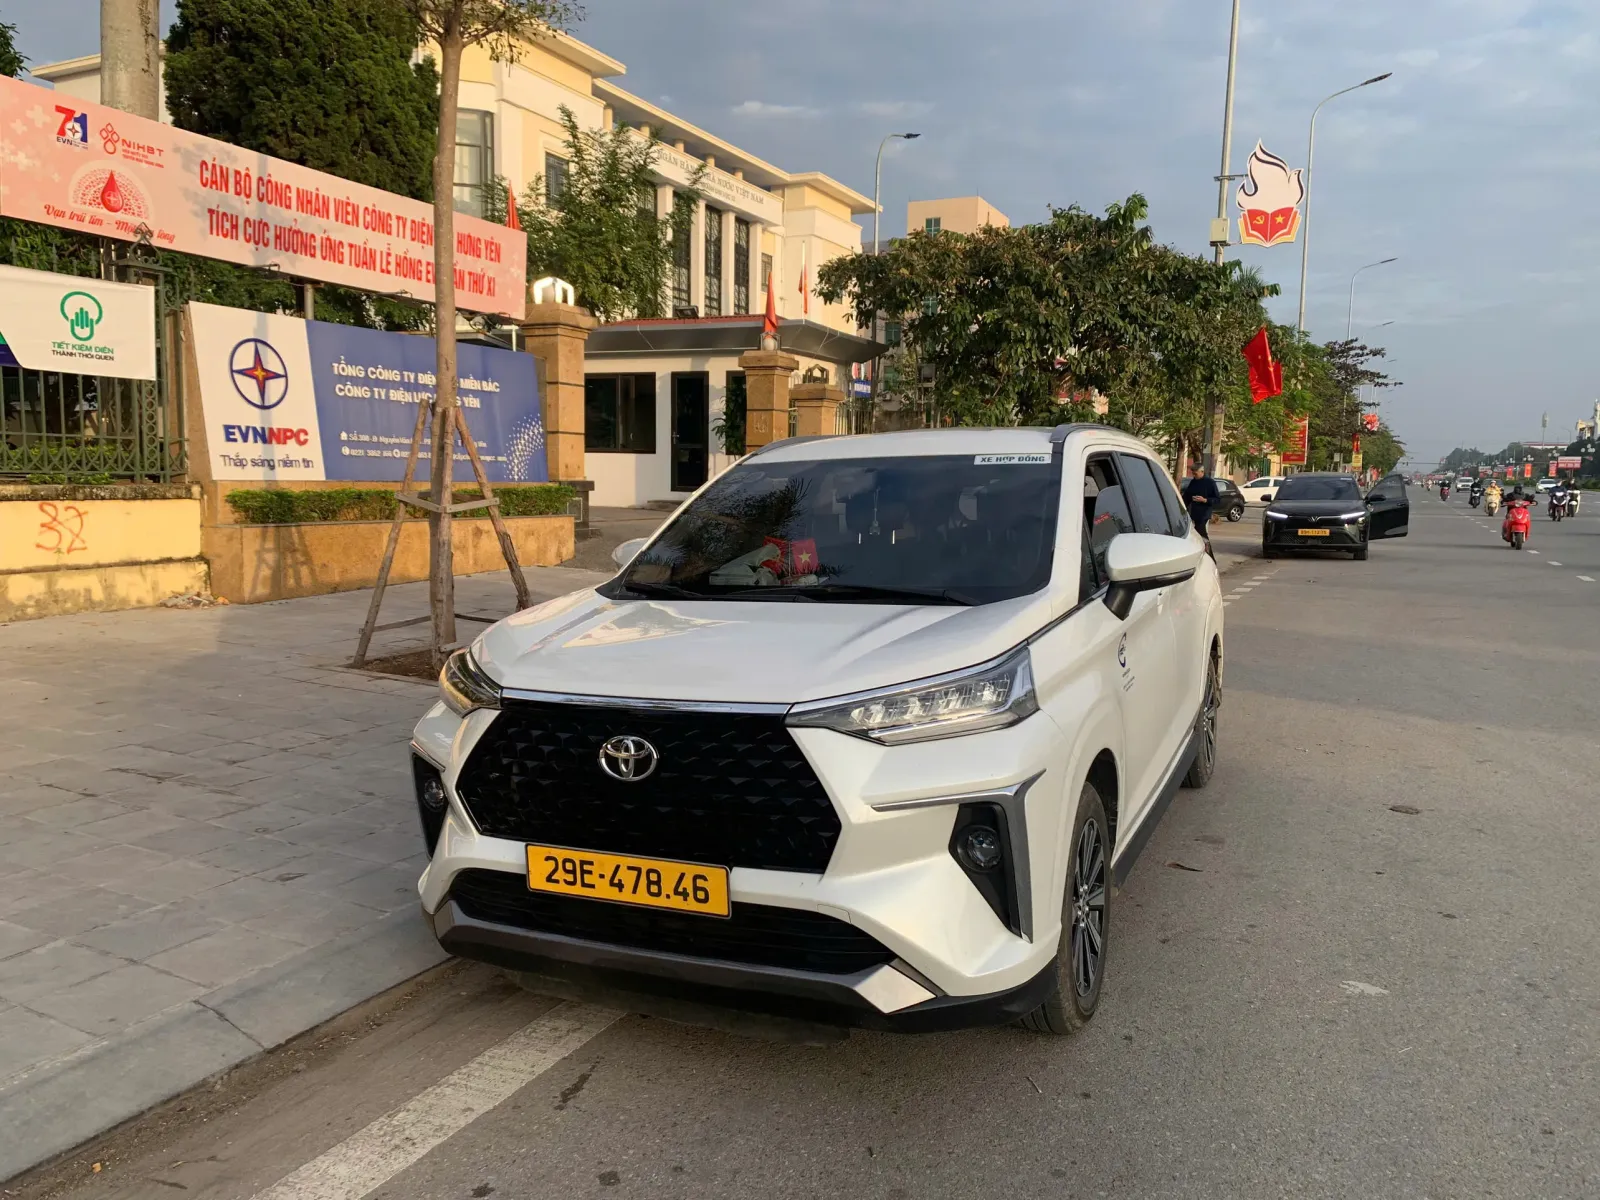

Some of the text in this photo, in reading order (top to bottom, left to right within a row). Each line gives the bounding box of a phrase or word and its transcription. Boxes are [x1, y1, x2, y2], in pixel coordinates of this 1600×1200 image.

[56, 136, 73, 146] EVN
[121, 138, 164, 157] NIHBT
[199, 157, 229, 194] CÁN
[234, 166, 252, 205] BỘ
[257, 173, 292, 210] CÔNG
[296, 187, 330, 220] NHÂN
[334, 196, 360, 228] VIÊN
[363, 203, 393, 236] CÔNG
[395, 214, 408, 239] TY
[410, 217, 434, 249] ĐIỆN
[484, 236, 502, 264] YÊN
[207, 204, 239, 241] TÍCH
[243, 216, 270, 252] CỰC
[274, 218, 317, 259] HƯỞNG
[320, 228, 345, 265] ỨNG
[348, 238, 377, 272] TUẦN
[380, 242, 392, 275] LỄ
[394, 248, 423, 282] HỒNG
[467, 267, 486, 295] THỨ
[486, 275, 496, 297] XI
[332, 355, 366, 378] TỔNG
[367, 365, 401, 382] CÔNG
[403, 371, 416, 384] TY
[460, 373, 482, 391] MIỀN
[335, 381, 371, 399] CÔNG
[373, 387, 386, 400] TY
[389, 387, 413, 405] ĐIỆN
[463, 394, 480, 409] YÊN
[222, 424, 309, 446] EVNNPC
[250, 455, 275, 470] sáng
[301, 457, 314, 468] tin
[995, 455, 1016, 464] HỢP
[1017, 454, 1046, 463] ĐỒNG
[544, 856, 710, 904] 29E-478.46
